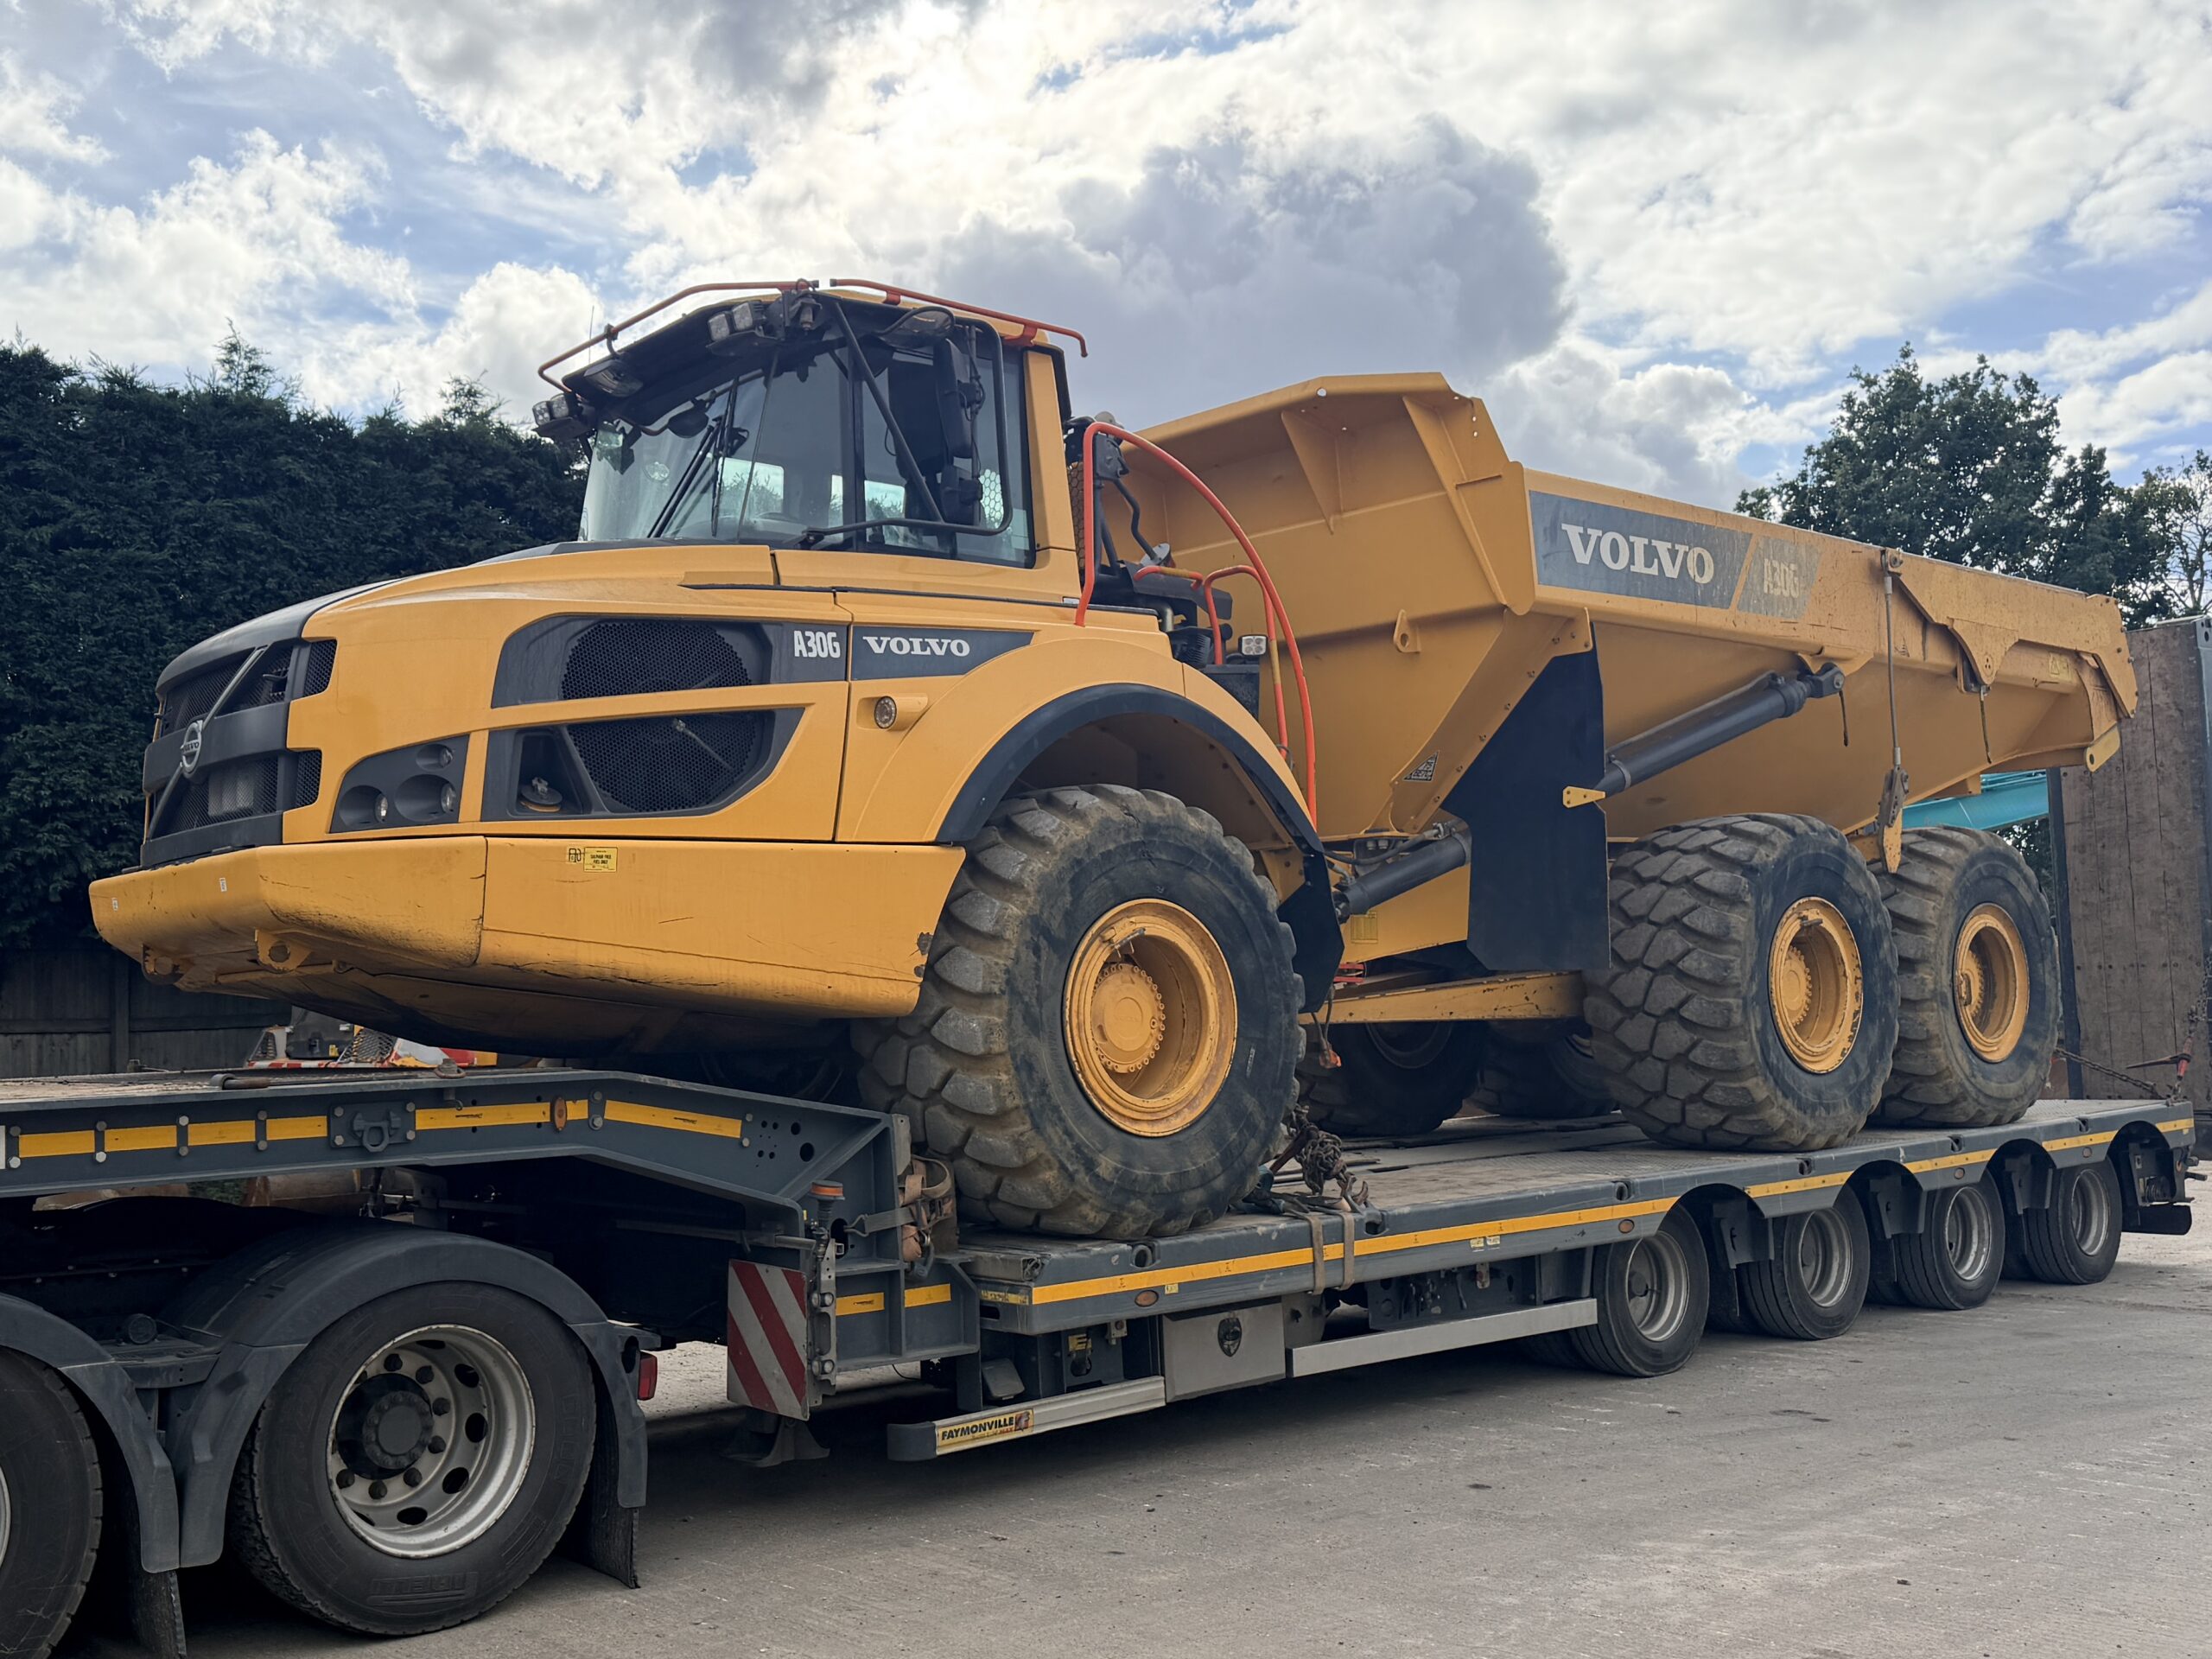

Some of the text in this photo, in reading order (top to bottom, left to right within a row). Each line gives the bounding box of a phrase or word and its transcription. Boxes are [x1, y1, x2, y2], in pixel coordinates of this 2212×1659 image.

[1561, 523, 1714, 584] VOLVO
[1763, 558, 1799, 598] A30G
[793, 630, 841, 658] A30G
[862, 636, 970, 657] VOLVO
[942, 1416, 1014, 1440] FAYMONVILLE
